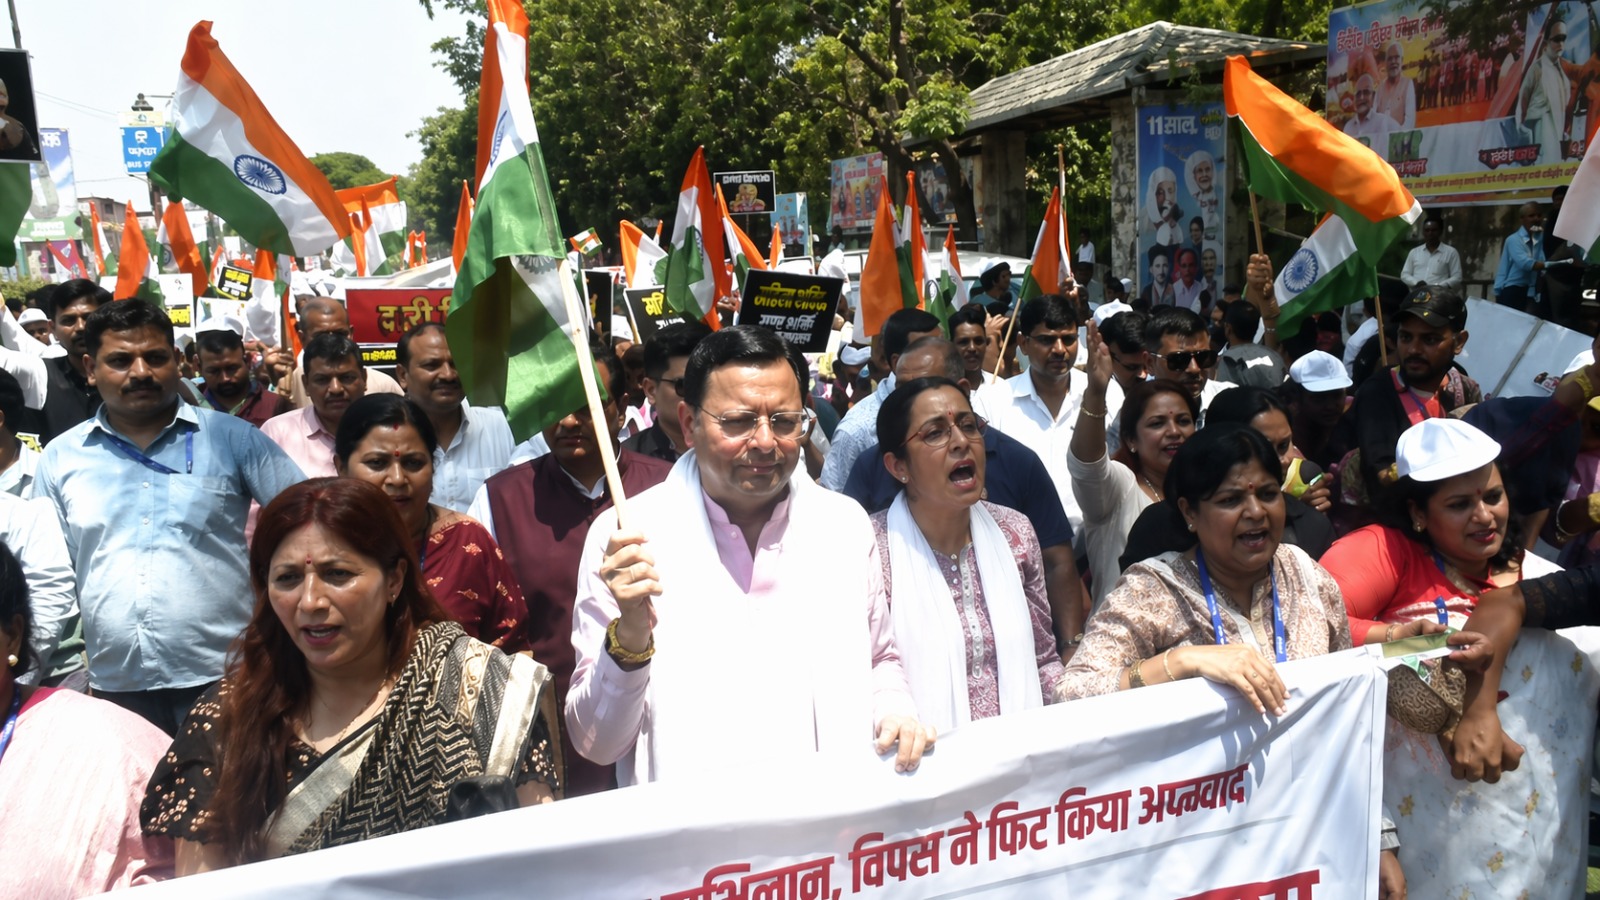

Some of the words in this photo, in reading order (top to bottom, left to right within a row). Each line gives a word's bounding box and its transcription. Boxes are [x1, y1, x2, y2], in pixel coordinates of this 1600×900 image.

[1147, 116, 1163, 135] 11
[947, 810, 982, 866] ने
[986, 801, 1052, 861] फिट
[1055, 786, 1132, 845] किया
